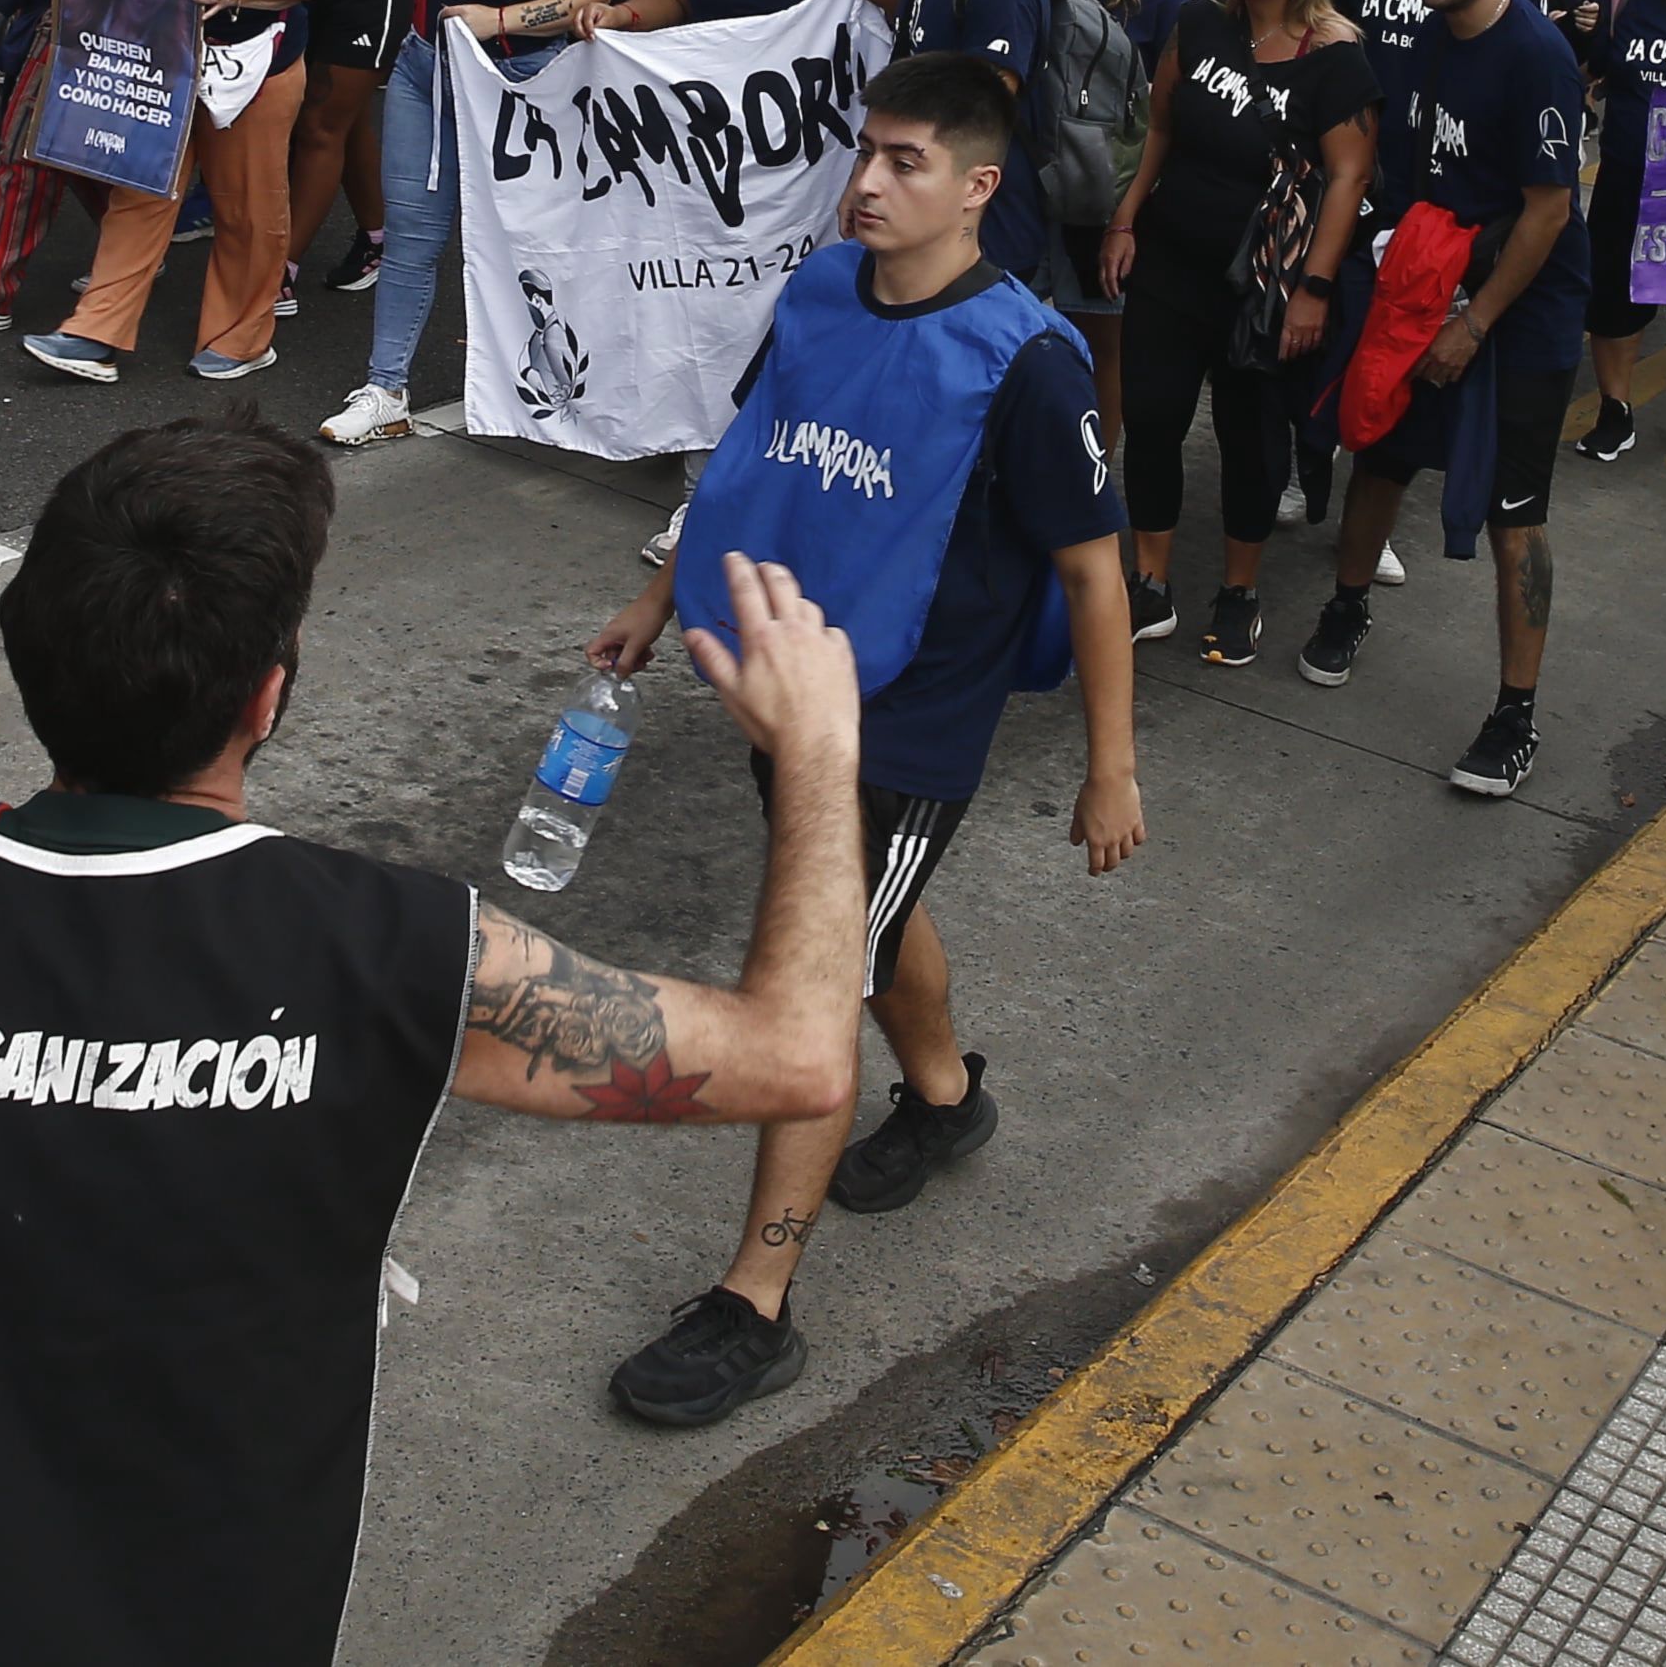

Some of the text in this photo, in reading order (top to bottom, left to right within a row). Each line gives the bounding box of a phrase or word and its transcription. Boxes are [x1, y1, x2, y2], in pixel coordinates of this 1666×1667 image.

[79, 31, 152, 63] QUIEREN
[1382, 29, 1397, 45] LA
[1625, 38, 1646, 61] LA
[87, 52, 164, 86] BAJARLA
[1191, 56, 1217, 84] LA
[74, 68, 172, 108] Y NO SABEN
[58, 84, 173, 128] COMO HACER
[85, 127, 126, 155] LA CAMPORA
[493, 22, 866, 227] LA CAMPORA
[628, 233, 815, 291] VILLA 21-24
